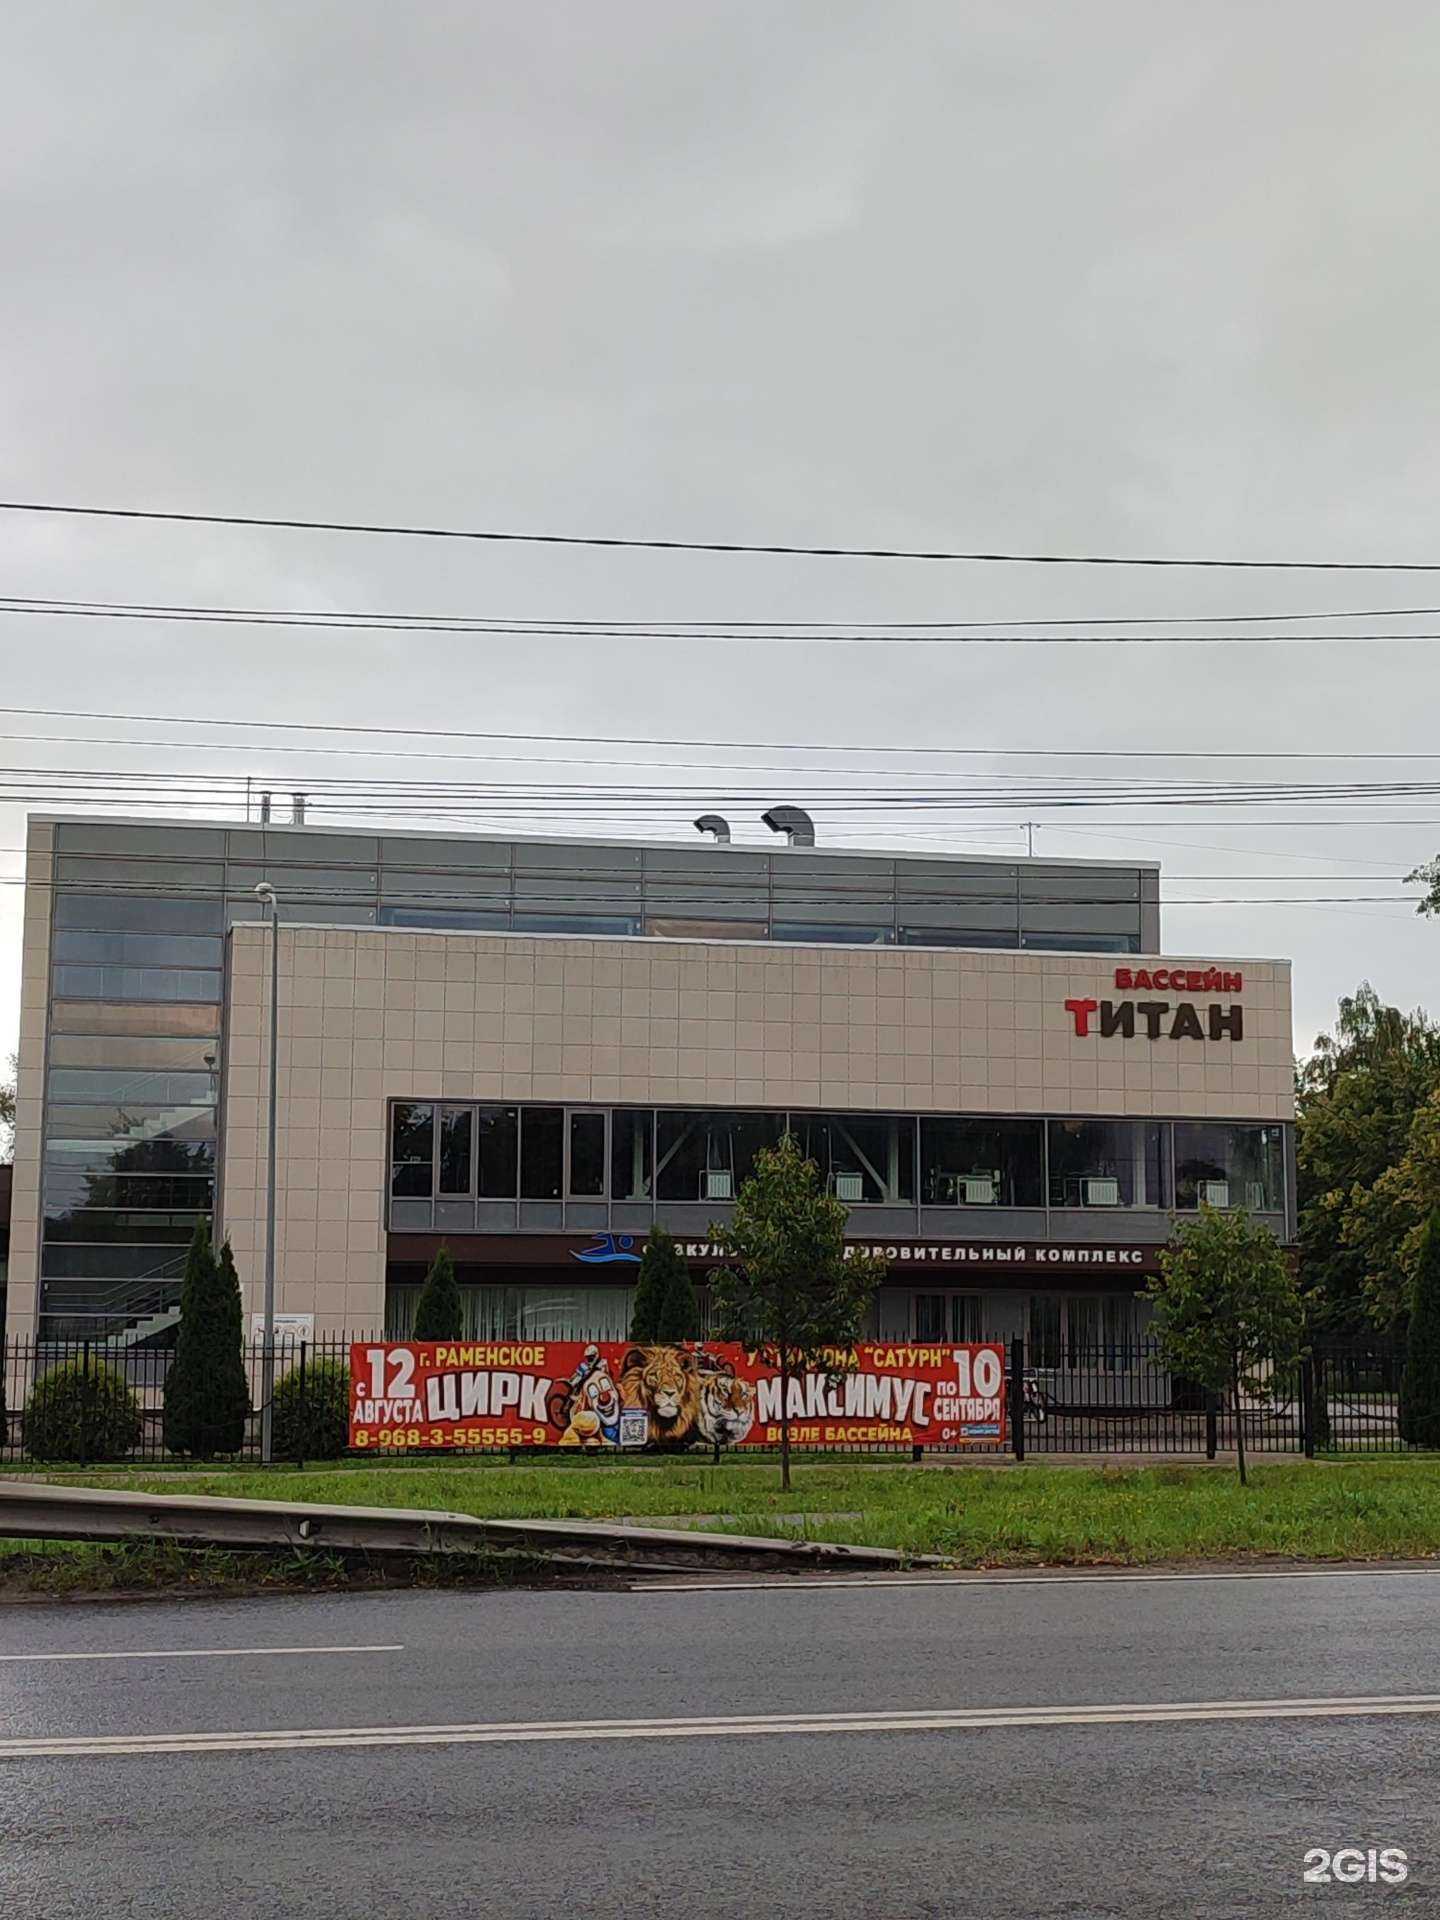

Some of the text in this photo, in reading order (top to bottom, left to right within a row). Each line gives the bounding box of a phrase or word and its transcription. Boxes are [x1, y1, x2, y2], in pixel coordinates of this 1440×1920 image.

[1115, 967, 1243, 993] БАССЕЙН
[1065, 999, 1243, 1041] ТИТАН
[1035, 1248, 1143, 1263] КОМПЛЕКС
[436, 1346, 545, 1366] РАМЕНСКОЕ
[366, 1348, 416, 1398] 12
[954, 1349, 1001, 1397] 10
[426, 1371, 552, 1422] ЦИРК
[352, 1399, 424, 1425] АВГУСТА
[933, 1398, 1000, 1421] СЕНТЯБРЯ
[355, 1428, 546, 1446] 8-968-3-55555-9
[825, 1424, 913, 1442] БАССЕЙНА
[942, 1427, 957, 1440] 0+
